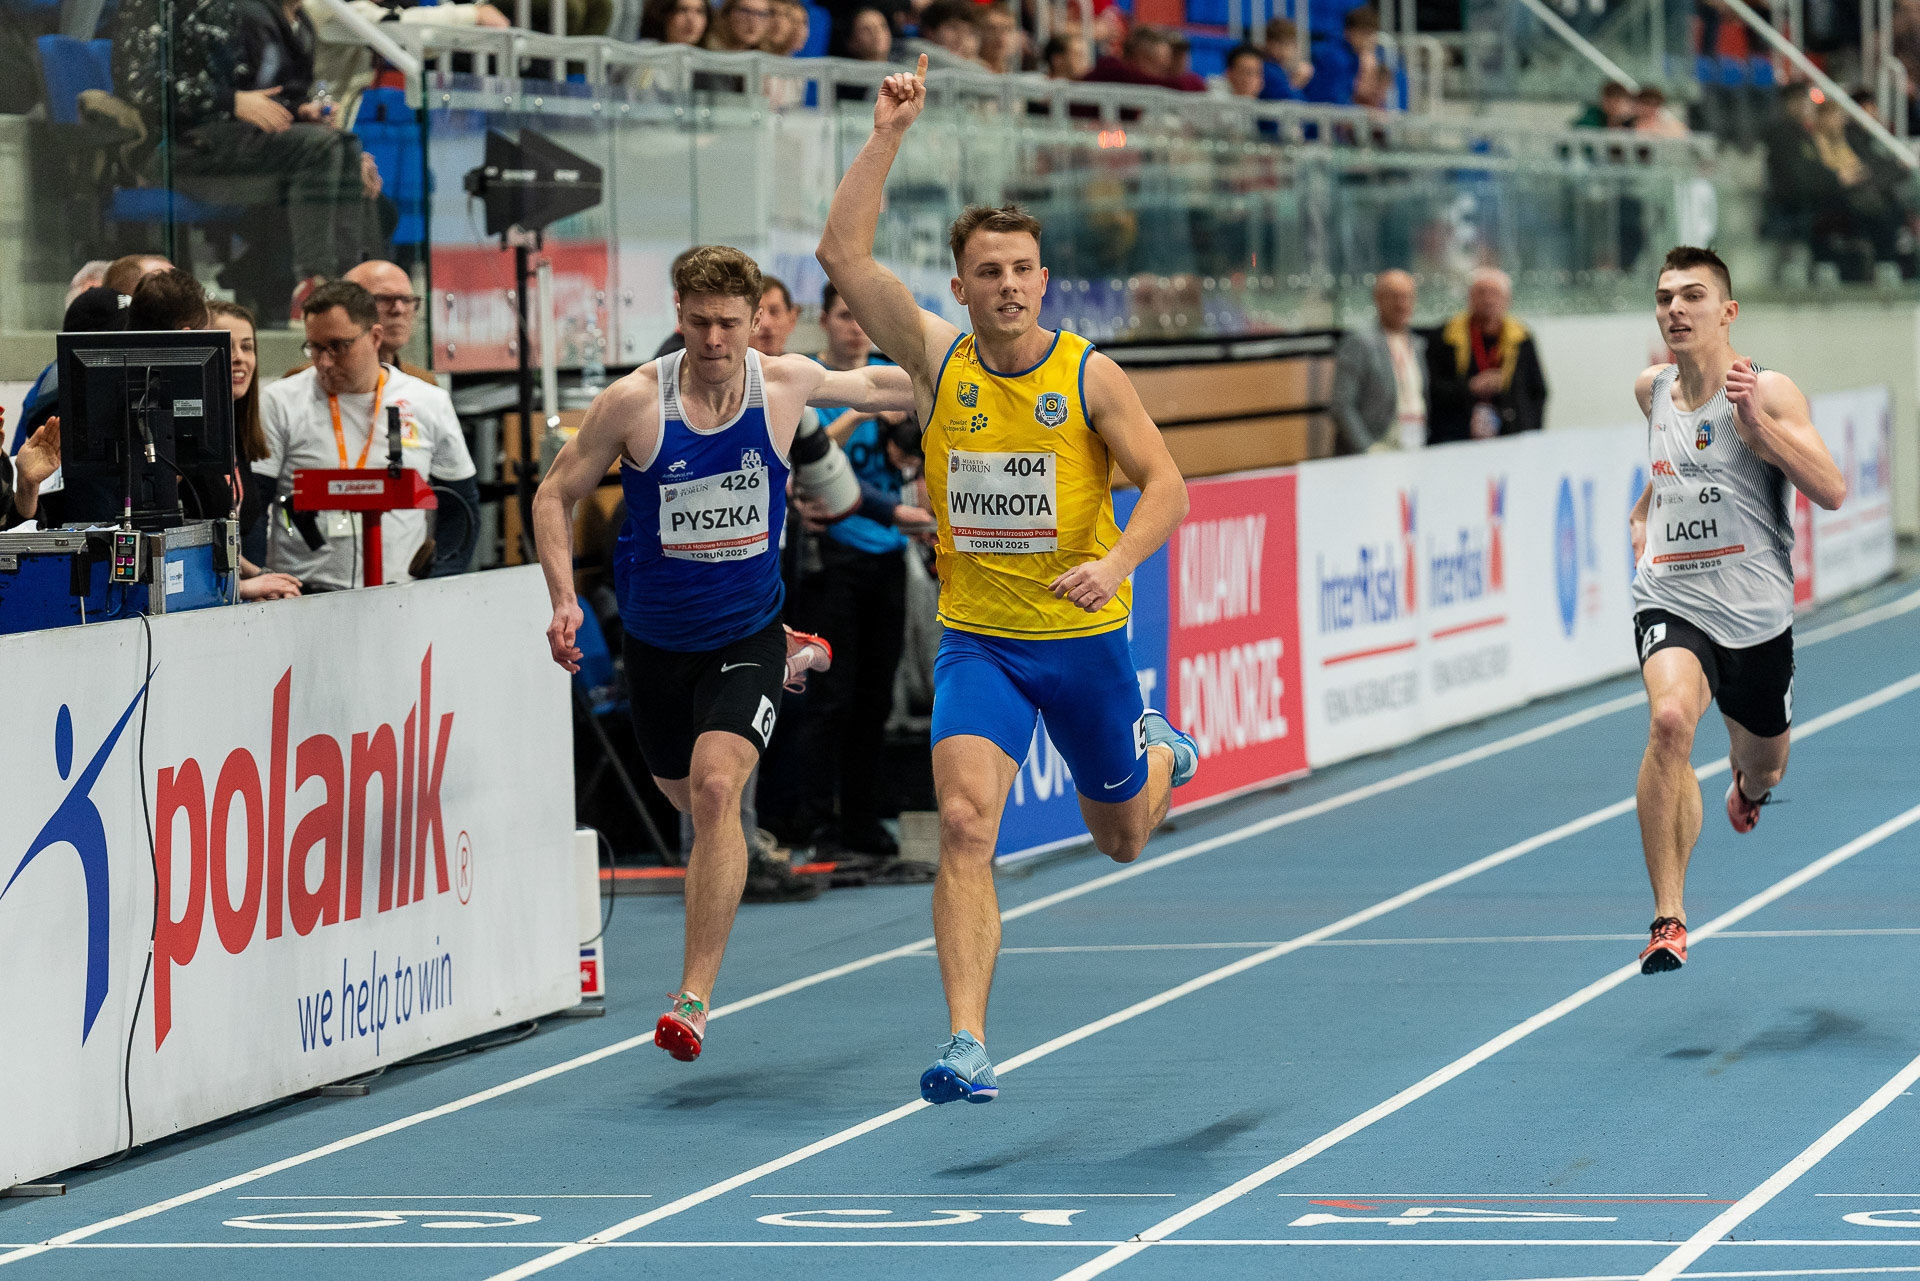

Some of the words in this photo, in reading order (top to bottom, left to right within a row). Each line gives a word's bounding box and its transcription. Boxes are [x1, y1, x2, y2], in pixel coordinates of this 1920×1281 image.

[961, 463, 991, 473] TORUŃ
[1003, 457, 1047, 477] 404
[720, 471, 760, 491] 426
[950, 491, 1053, 516] WYKROTA
[1699, 487, 1721, 504] 65
[671, 504, 760, 532] PYSZKA
[1666, 519, 1718, 541] LACH
[691, 549, 723, 559] TORUŃ
[725, 548, 748, 557] 2025
[693, 541, 716, 549] Halowe
[716, 537, 751, 547] Mistrzostwa
[970, 539, 1003, 549] TORUŃ
[1005, 541, 1030, 549] 2025
[1179, 513, 1267, 629] KUJAWY
[1668, 561, 1698, 572] TORUŃ
[1700, 559, 1722, 569] 2025
[1644, 628, 1658, 650] 4
[1179, 637, 1289, 759] POMORZE
[761, 706, 774, 738] 6
[1139, 715, 1147, 750] 5
[153, 642, 455, 1053] polanik
[297, 989, 333, 1053] we
[341, 950, 388, 1057] help
[395, 956, 413, 1025] to
[418, 935, 453, 1015] win
